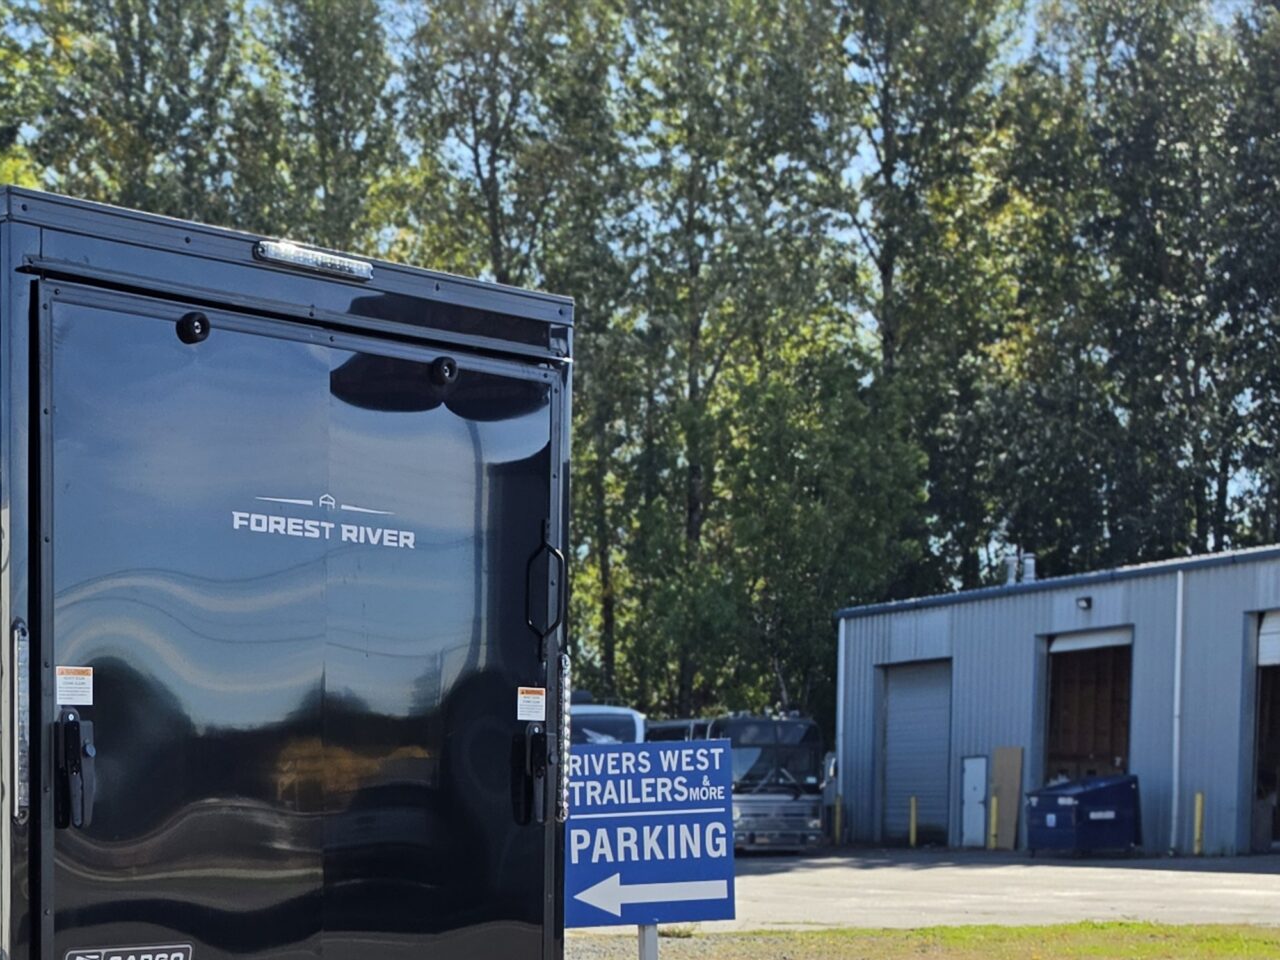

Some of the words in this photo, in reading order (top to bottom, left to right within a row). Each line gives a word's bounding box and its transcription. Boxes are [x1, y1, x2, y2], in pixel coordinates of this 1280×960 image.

[232, 511, 335, 539] FOREST
[341, 524, 415, 549] RIVER
[569, 751, 651, 776] RIVERS
[660, 748, 724, 772] WEST
[570, 776, 688, 806] TRAILERS
[689, 786, 725, 801] MORE
[702, 775, 710, 787] &
[570, 822, 727, 864] PARKING
